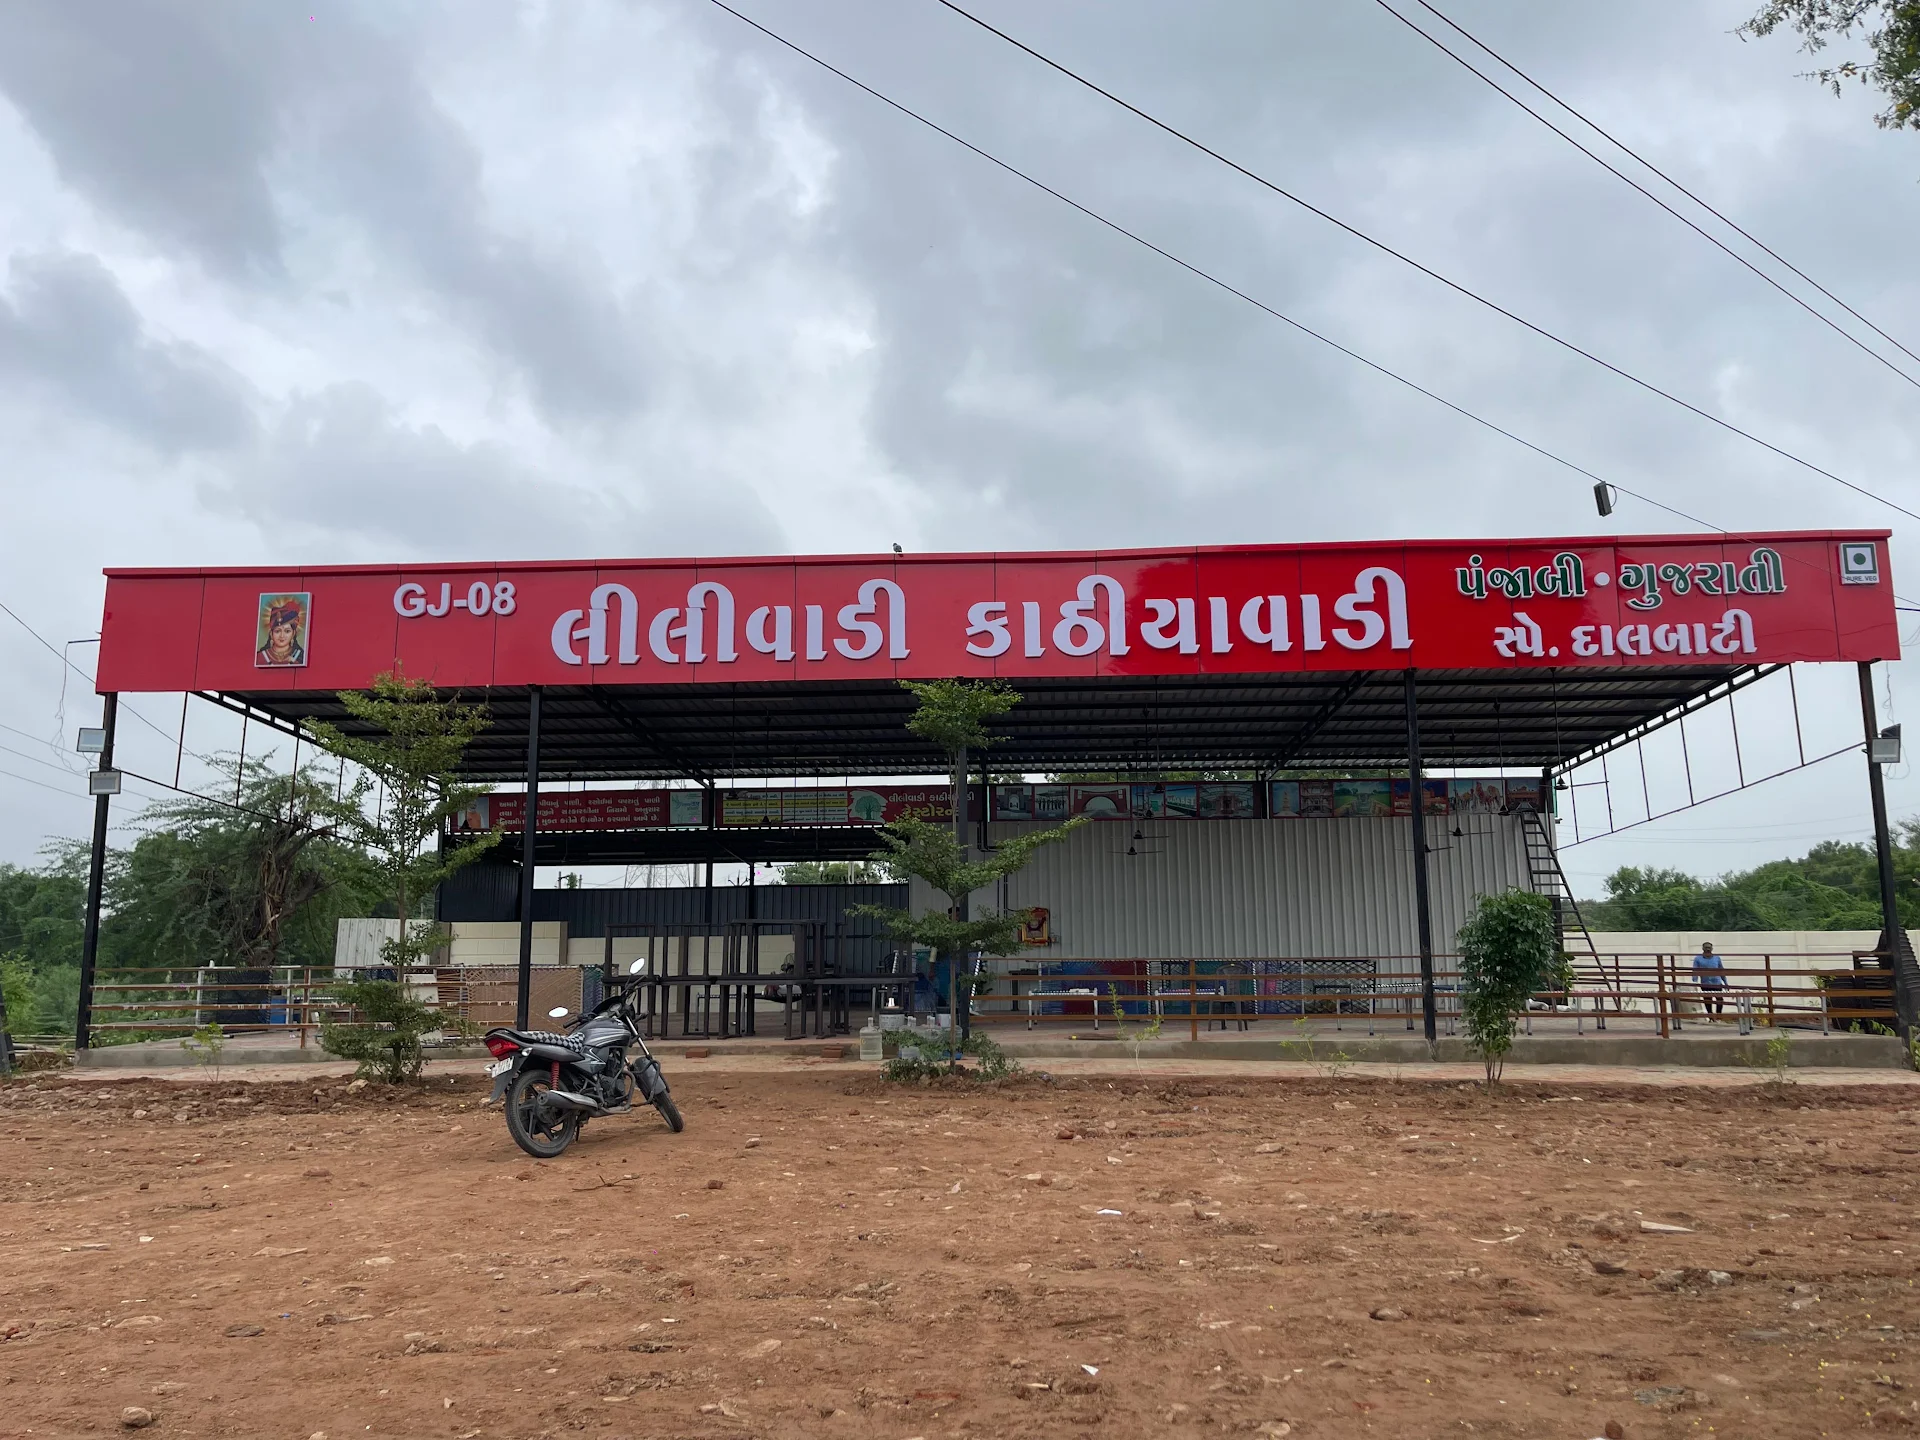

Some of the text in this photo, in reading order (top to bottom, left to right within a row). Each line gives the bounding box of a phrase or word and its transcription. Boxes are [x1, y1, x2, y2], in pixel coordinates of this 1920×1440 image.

[394, 580, 517, 618] GJ-08
[1455, 548, 1787, 611] પંજાબી ગુજરાતી
[551, 566, 1414, 666] લીલીવાડી કાઠીયાવાડી
[1570, 608, 1758, 657] દાલબાટી
[888, 791, 926, 802] લીલીવાડી
